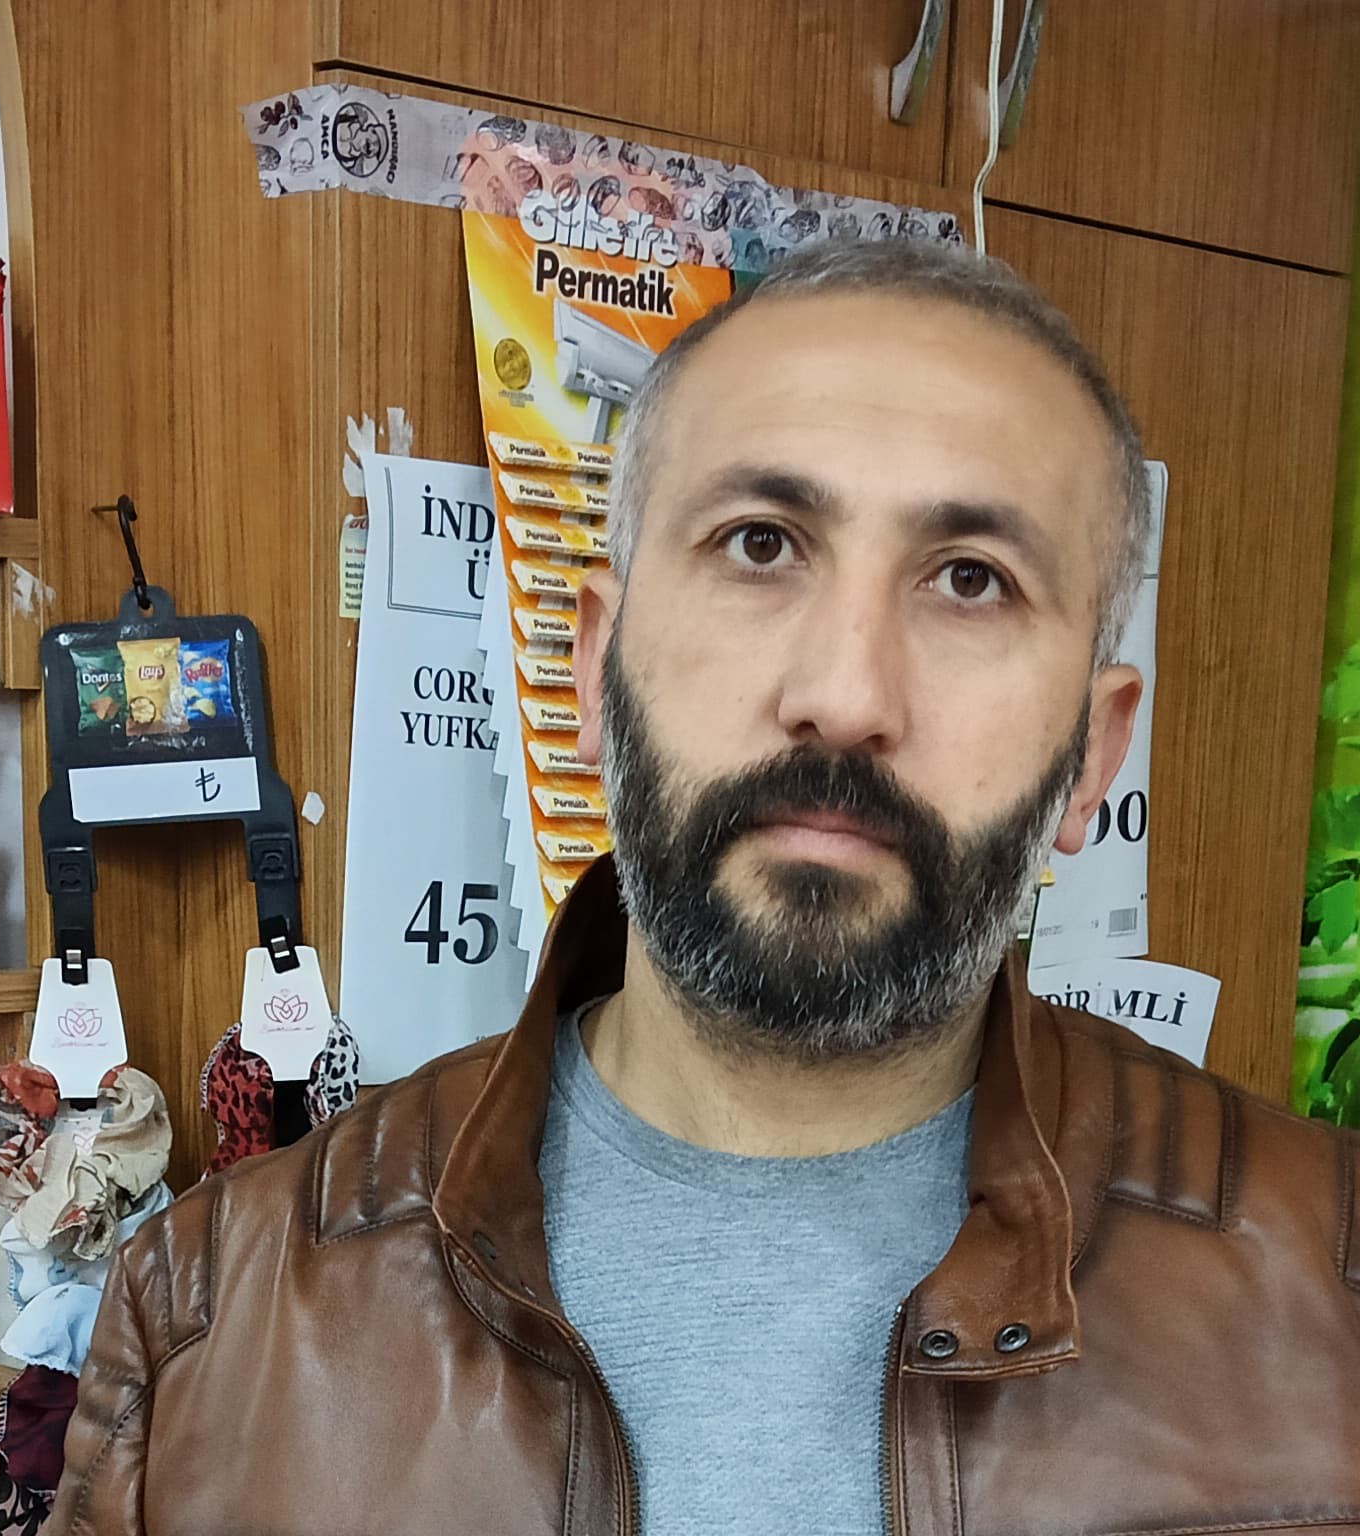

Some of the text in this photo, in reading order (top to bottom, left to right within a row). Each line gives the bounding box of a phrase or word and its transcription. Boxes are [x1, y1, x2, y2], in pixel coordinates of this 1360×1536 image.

[519, 189, 679, 268] Gillette
[535, 249, 675, 316] Permatik
[509, 444, 546, 458] Permatik
[519, 485, 555, 498] Permatik
[526, 529, 561, 543] Permatik
[531, 575, 567, 588] Permatik
[533, 618, 571, 633] Permatik
[81, 671, 122, 684] Doritos
[536, 664, 573, 678] Permatik
[540, 708, 578, 723] Permatik
[553, 796, 590, 810] Permatik
[558, 842, 595, 855] Permatik
[404, 880, 499, 964] 45
